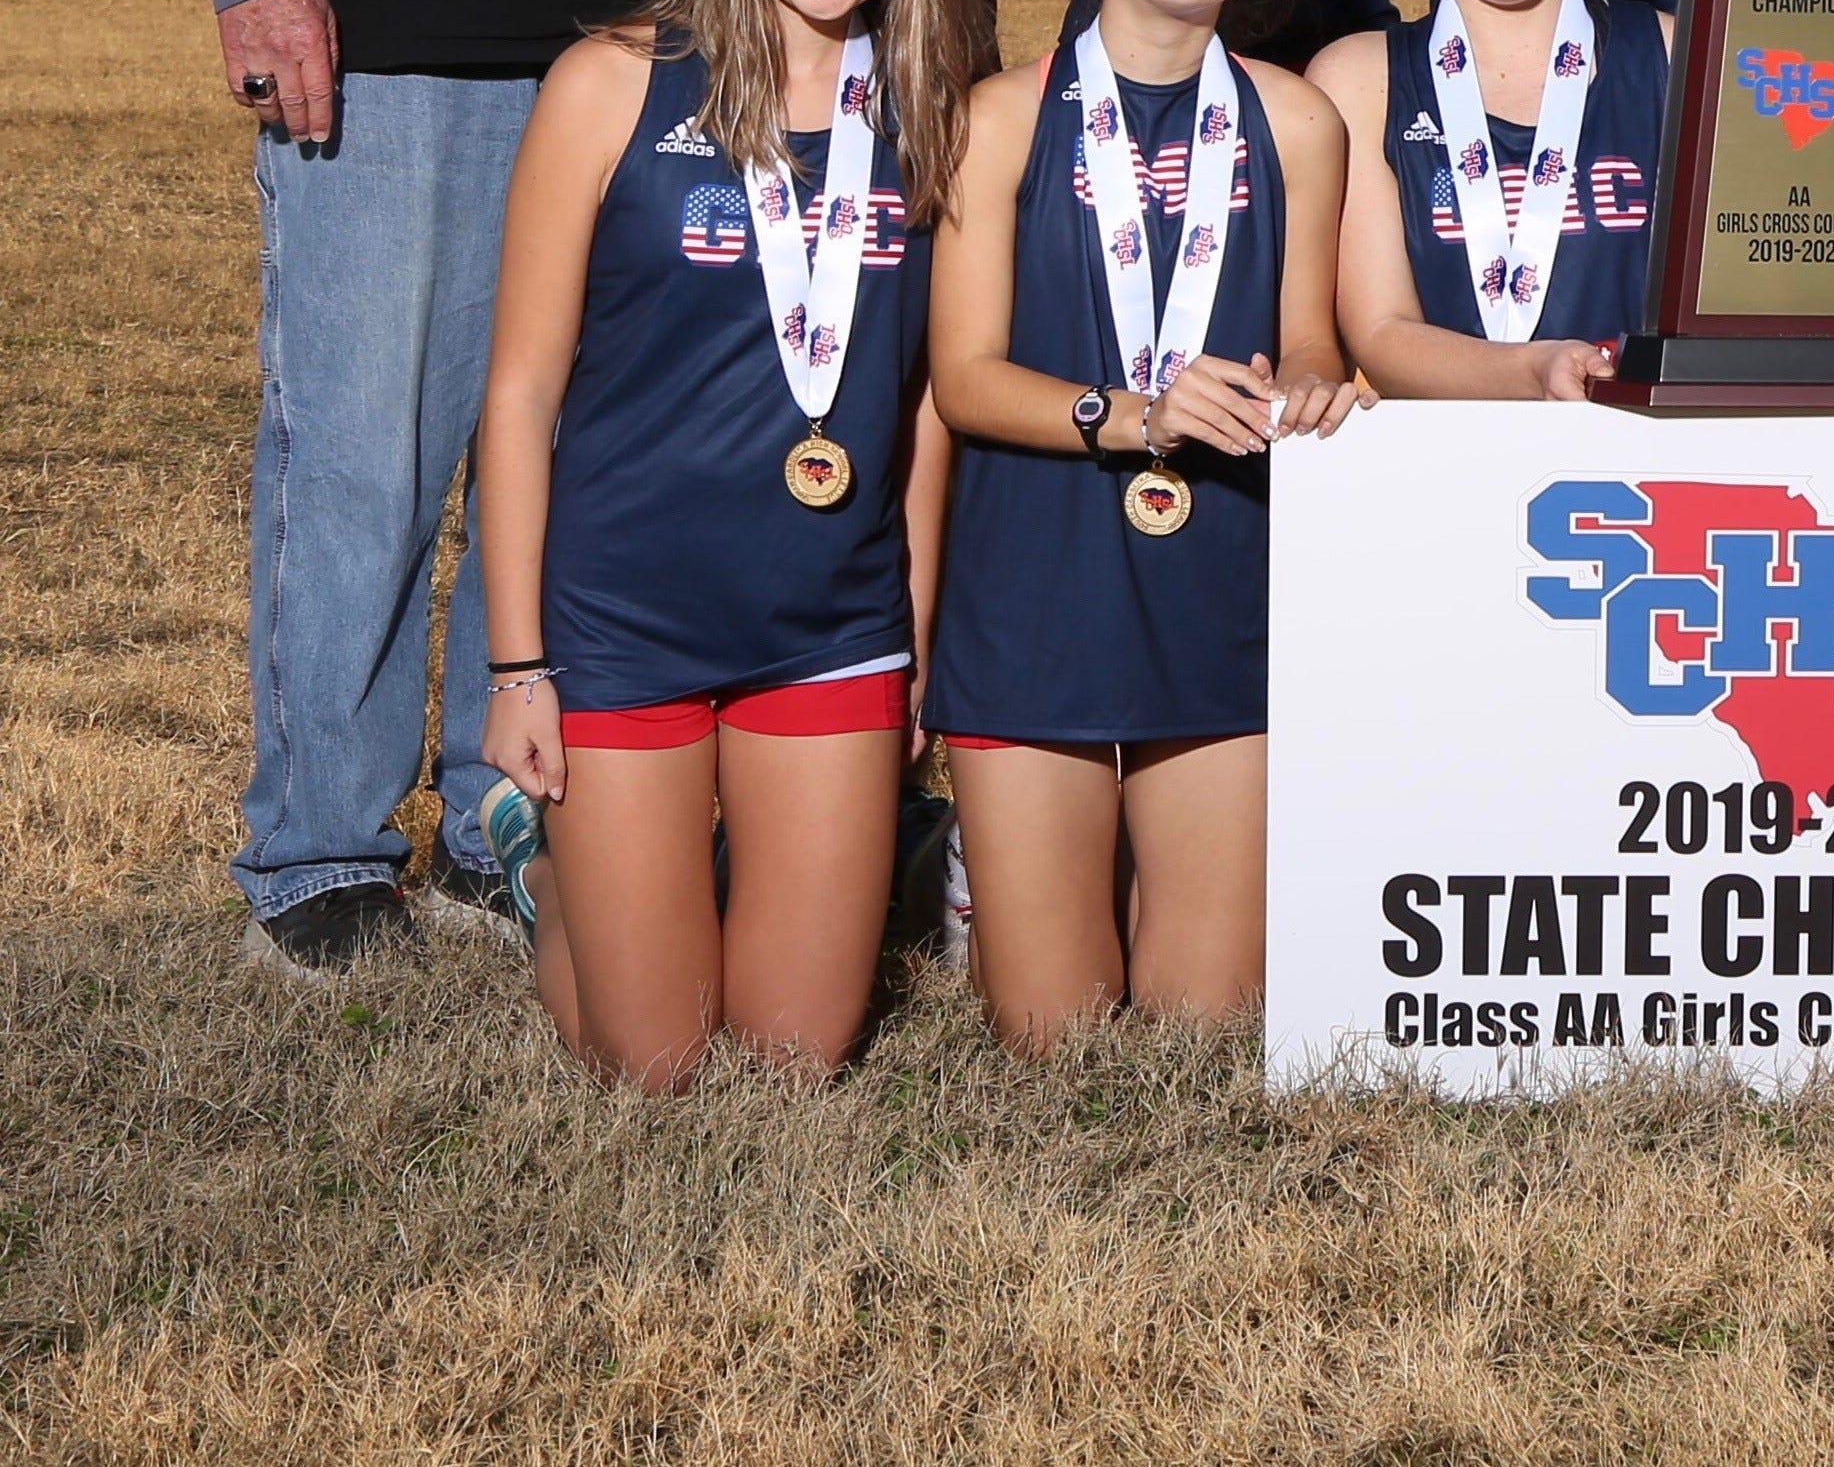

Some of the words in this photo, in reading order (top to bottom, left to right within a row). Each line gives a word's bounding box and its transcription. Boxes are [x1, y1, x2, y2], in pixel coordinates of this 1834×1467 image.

[655, 139, 716, 157] adidas
[1788, 186, 1811, 207] AA
[681, 184, 906, 271] GC
[1717, 213, 1758, 234] GIRLS
[1762, 213, 1810, 233] CROSS
[1382, 874, 1671, 977] STATE
[1385, 992, 1539, 1047] Class
[1553, 993, 1625, 1046] AA
[1643, 992, 1779, 1047] Girls
